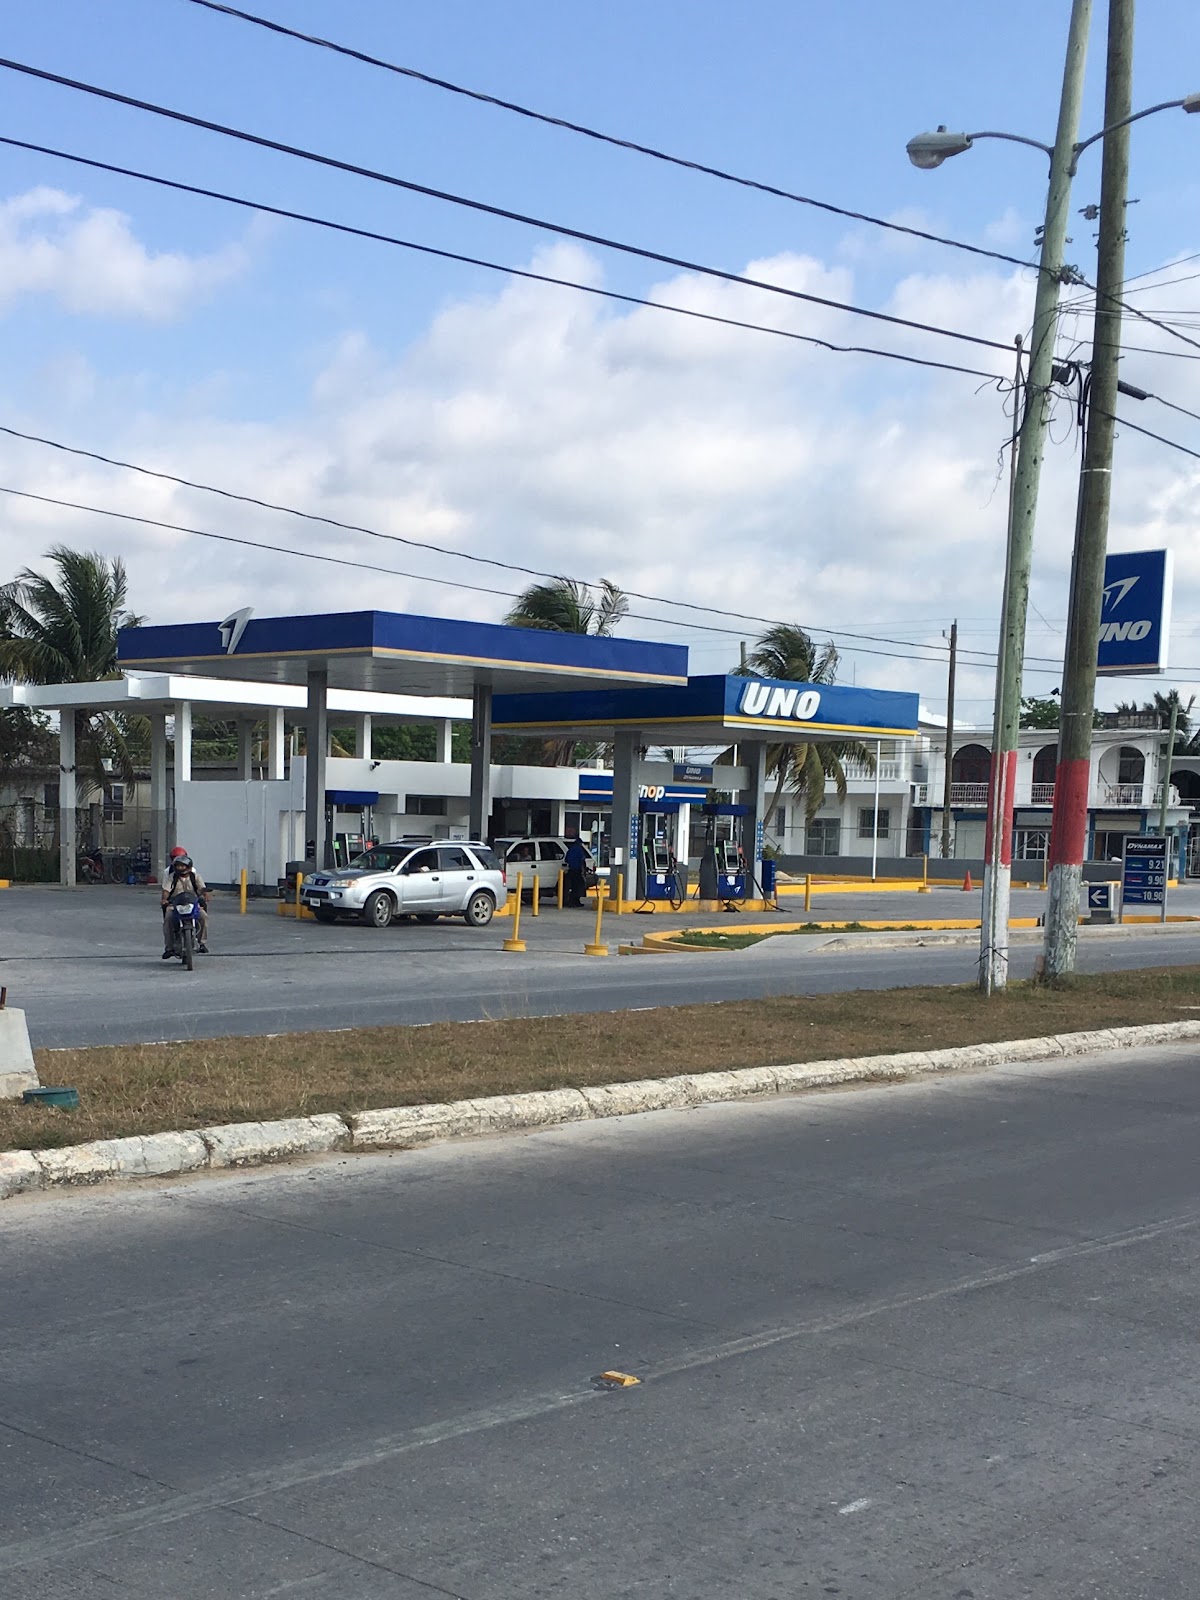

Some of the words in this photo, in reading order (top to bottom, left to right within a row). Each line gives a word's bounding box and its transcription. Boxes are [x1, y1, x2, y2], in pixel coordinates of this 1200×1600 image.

[740, 682, 821, 720] UNO
[685, 766, 702, 775] UNO
[638, 784, 665, 802] hop
[1148, 859, 1165, 870] 9.21
[1147, 875, 1164, 885] 9.90
[1143, 891, 1164, 901] 10.90
